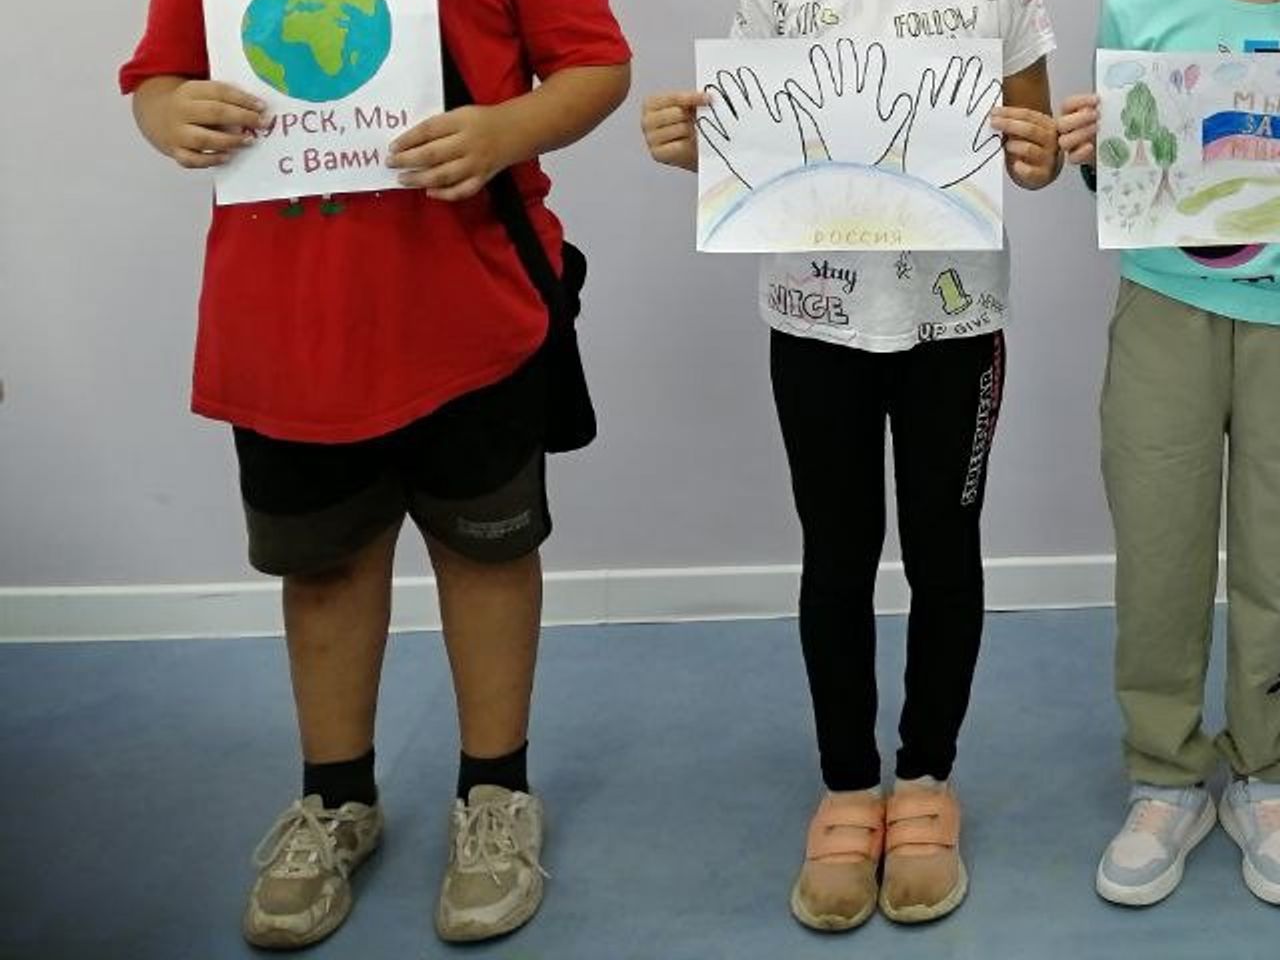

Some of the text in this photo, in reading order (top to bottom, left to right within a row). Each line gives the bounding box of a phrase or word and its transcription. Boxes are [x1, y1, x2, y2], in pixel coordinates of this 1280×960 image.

[354, 105, 408, 130] Мы
[303, 147, 379, 174] Вами
[814, 230, 902, 246] РОССИЯ
[768, 283, 850, 326] NICE
[954, 313, 991, 335] GIVE
